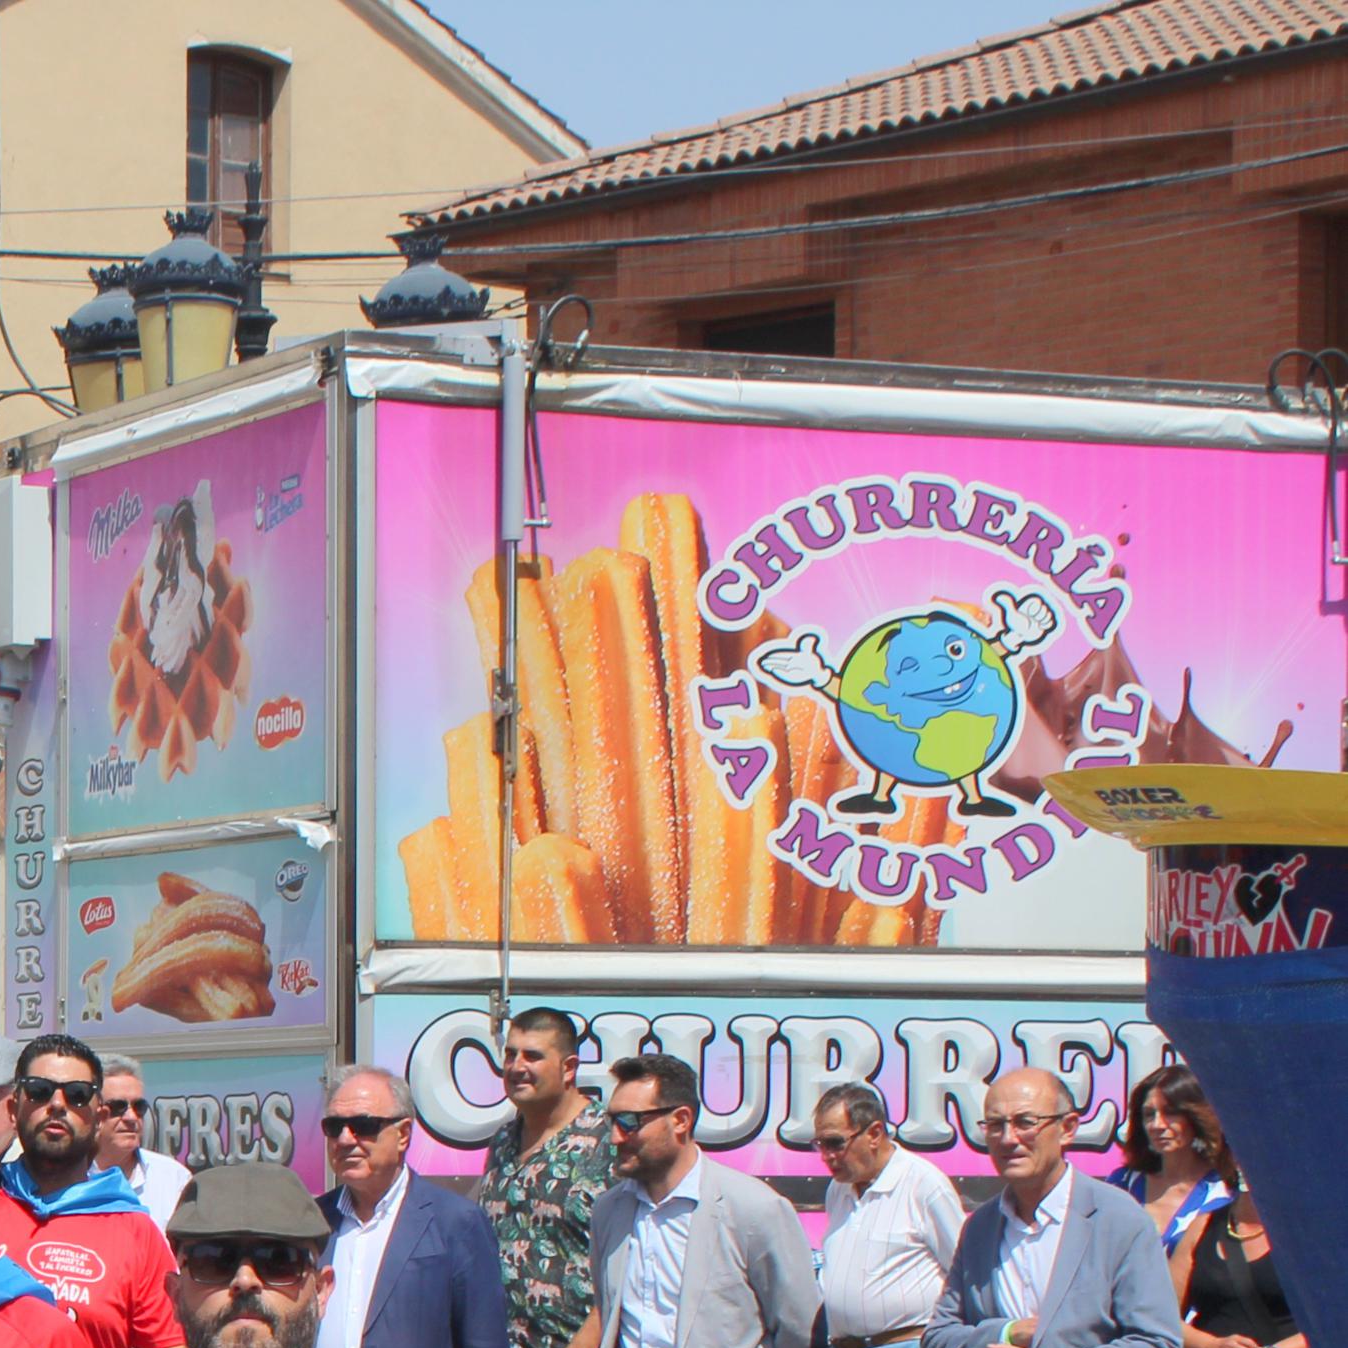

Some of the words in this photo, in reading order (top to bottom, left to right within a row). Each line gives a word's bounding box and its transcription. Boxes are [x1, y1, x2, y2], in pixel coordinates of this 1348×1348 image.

[89, 490, 141, 560] Milka
[705, 480, 1124, 641] CHURRERÍA
[257, 706, 302, 737] nocilla
[89, 755, 136, 795] Milkybar
[699, 679, 768, 800] LA
[776, 692, 1143, 900] MUNDIL
[1094, 786, 1187, 806] BOXER
[14, 758, 45, 1032] CHURRE
[276, 862, 308, 887] OREO
[84, 902, 112, 925] Lotus
[143, 1091, 295, 1168] FRES
